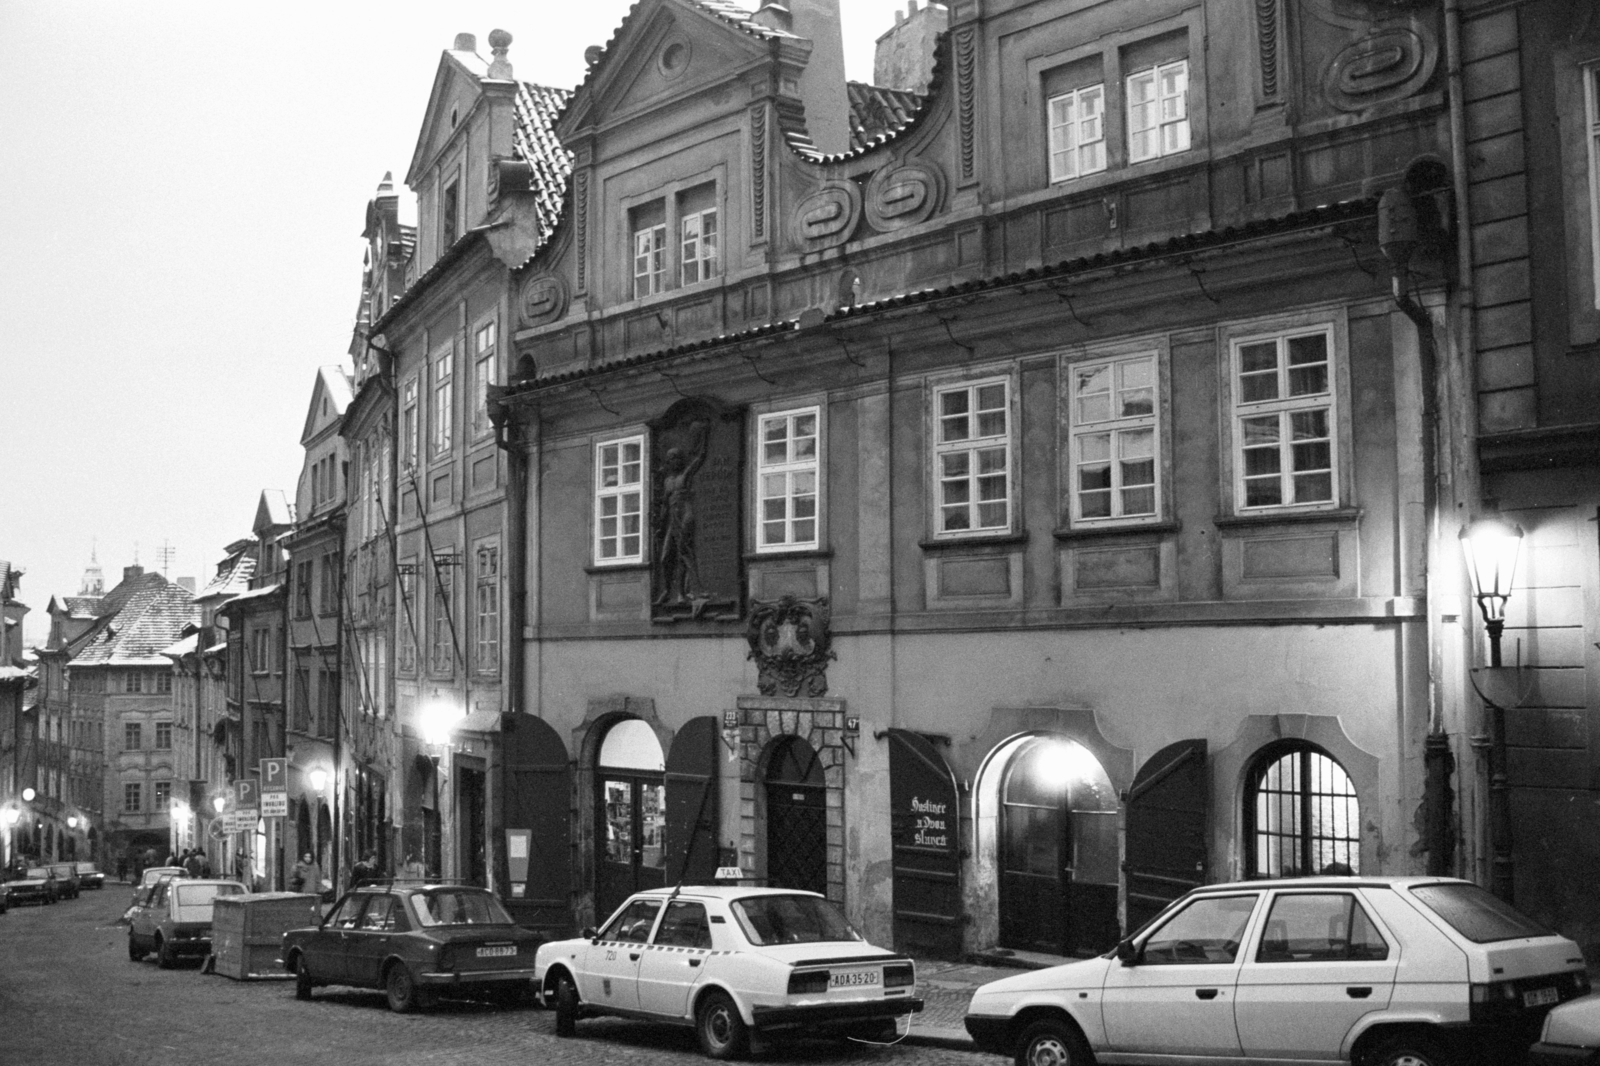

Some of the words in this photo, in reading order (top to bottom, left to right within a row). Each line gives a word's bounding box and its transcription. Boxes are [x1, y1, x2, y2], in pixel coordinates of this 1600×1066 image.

[848, 718, 857, 729] 47
[267, 762, 280, 782] P
[240, 783, 250, 800] P
[720, 868, 741, 877] TAXI
[605, 950, 617, 961] 720
